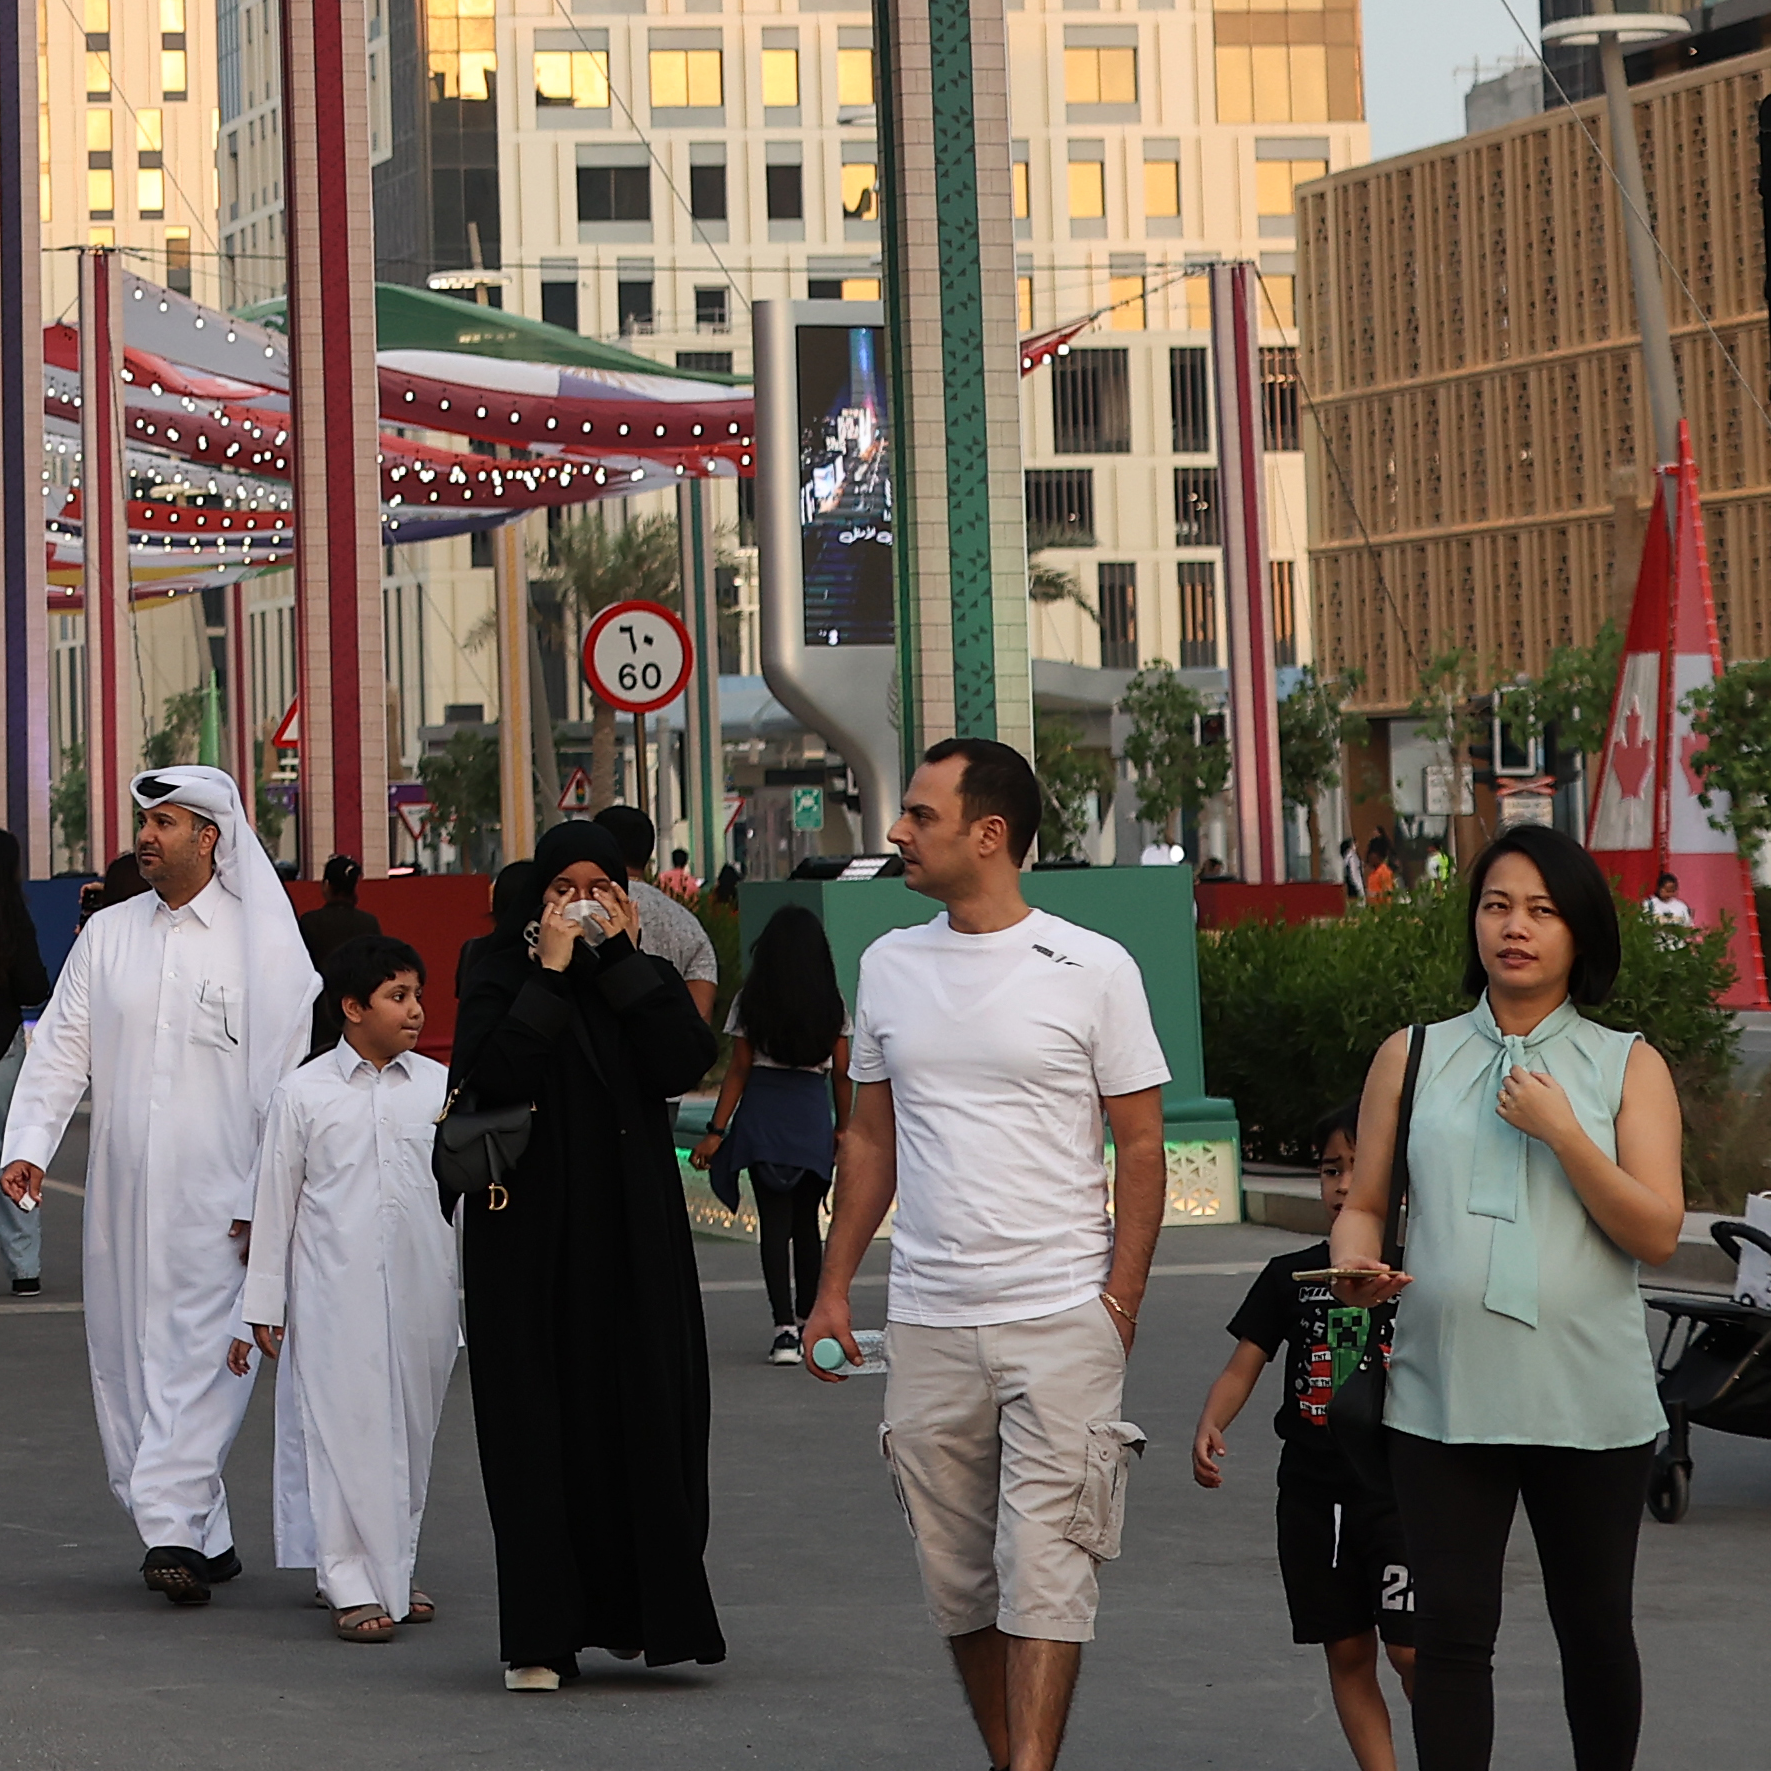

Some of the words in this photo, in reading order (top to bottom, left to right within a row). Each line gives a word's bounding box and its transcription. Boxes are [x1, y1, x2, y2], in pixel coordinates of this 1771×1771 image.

[619, 625, 654, 654] ٦٠
[618, 662, 662, 690] 60
[489, 1183, 509, 1210] D
